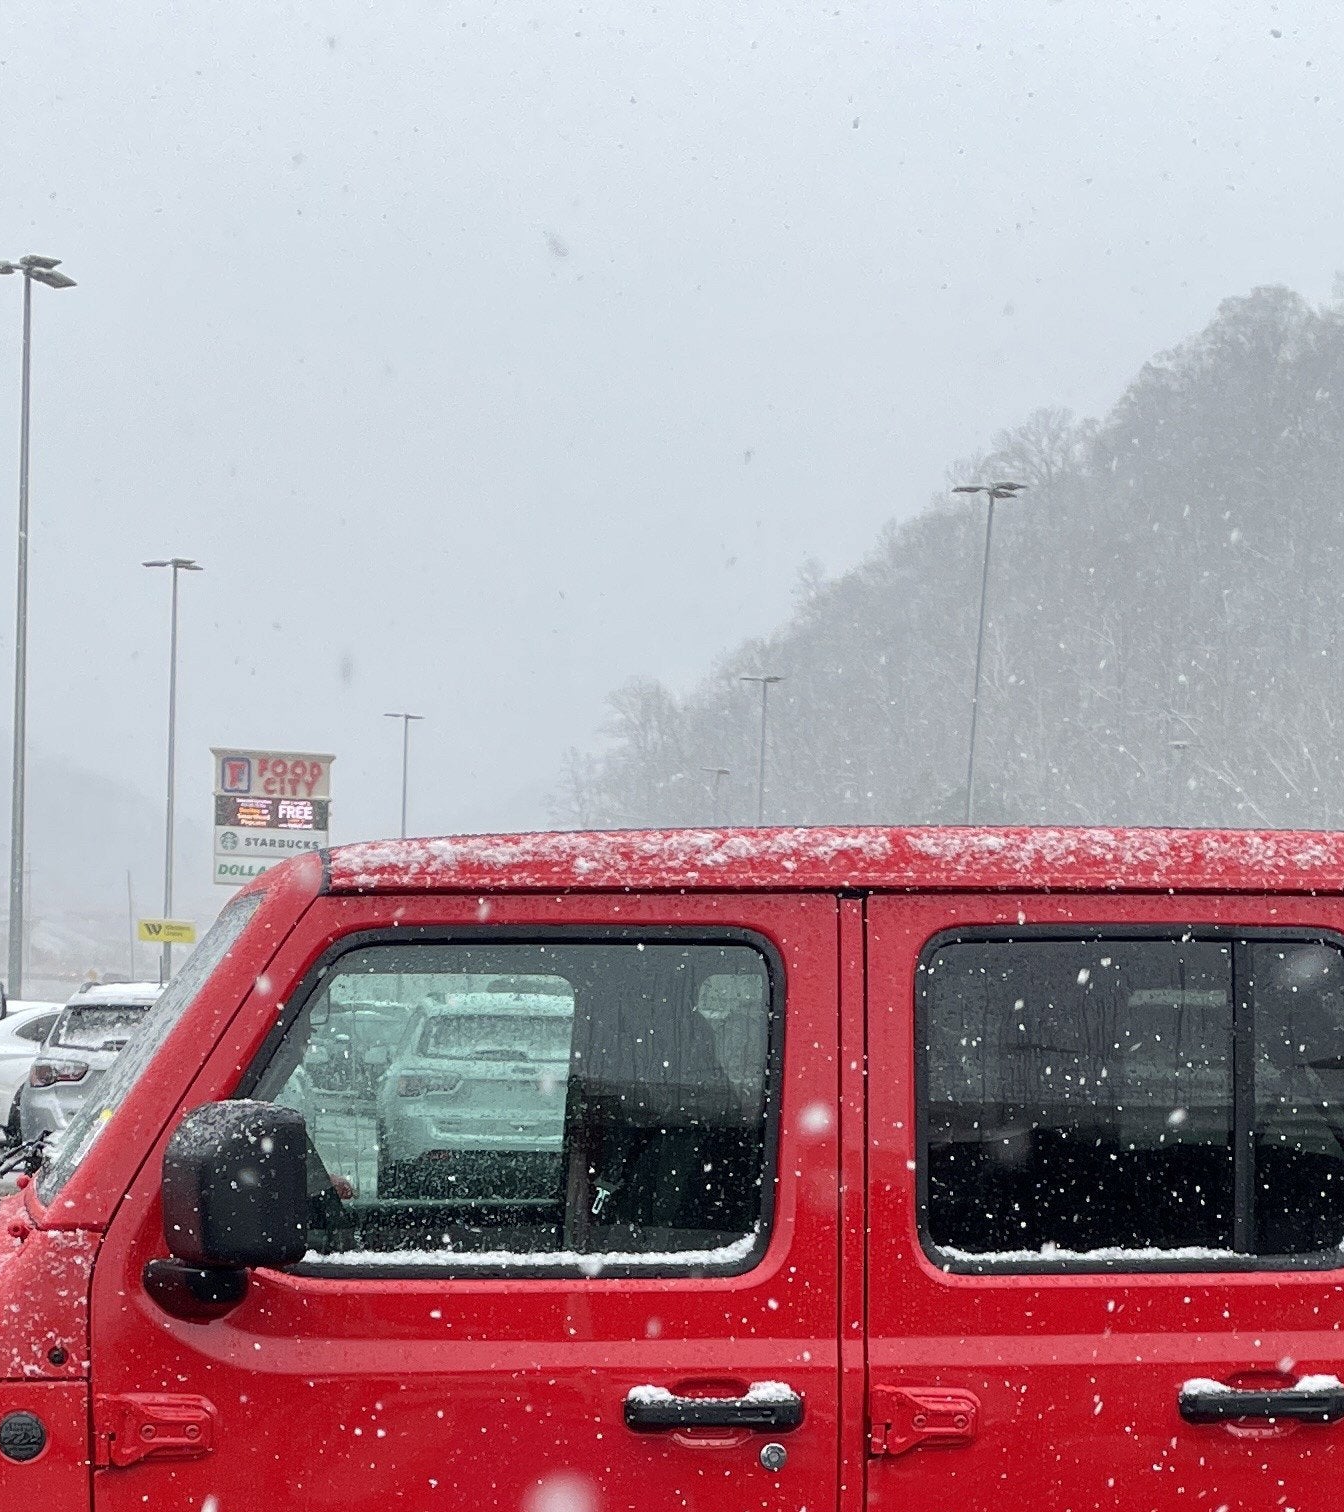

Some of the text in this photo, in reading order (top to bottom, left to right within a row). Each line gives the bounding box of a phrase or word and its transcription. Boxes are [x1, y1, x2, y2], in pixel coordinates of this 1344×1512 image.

[258, 757, 322, 780] FOOD
[263, 777, 317, 797] CITY
[278, 805, 313, 820] FREE
[244, 837, 319, 850] STARBUCKS
